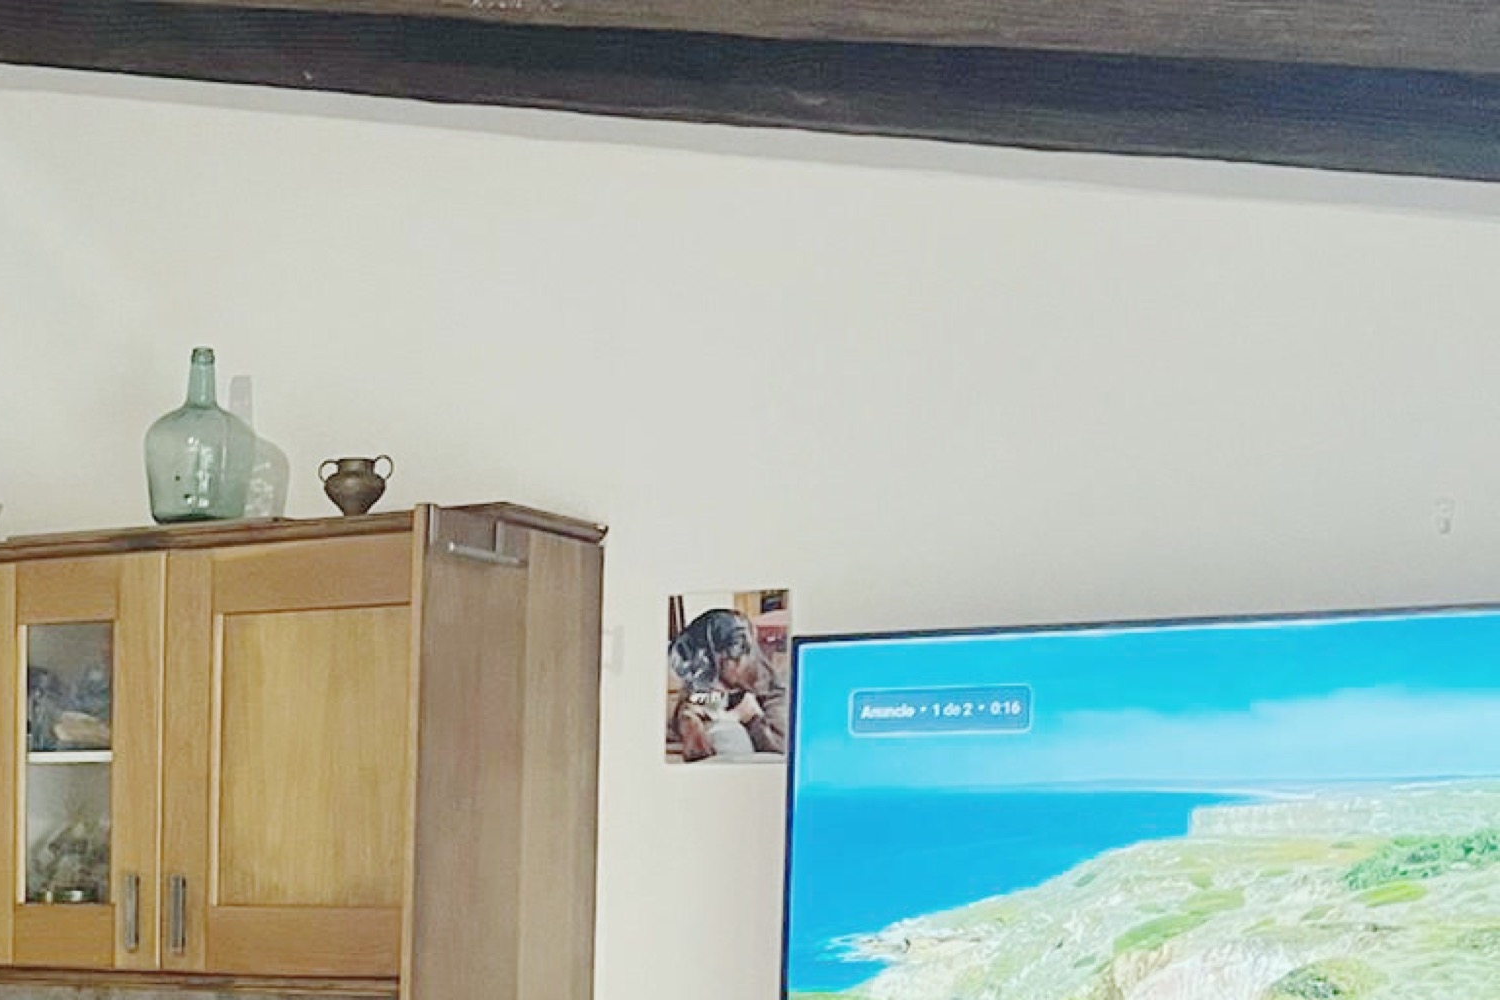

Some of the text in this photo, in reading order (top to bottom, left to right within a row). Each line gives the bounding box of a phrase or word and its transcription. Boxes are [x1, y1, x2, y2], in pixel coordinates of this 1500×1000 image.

[860, 703, 915, 719] Anuncio
[932, 703, 940, 717] 1
[942, 702, 961, 717] de
[962, 702, 973, 716] 2
